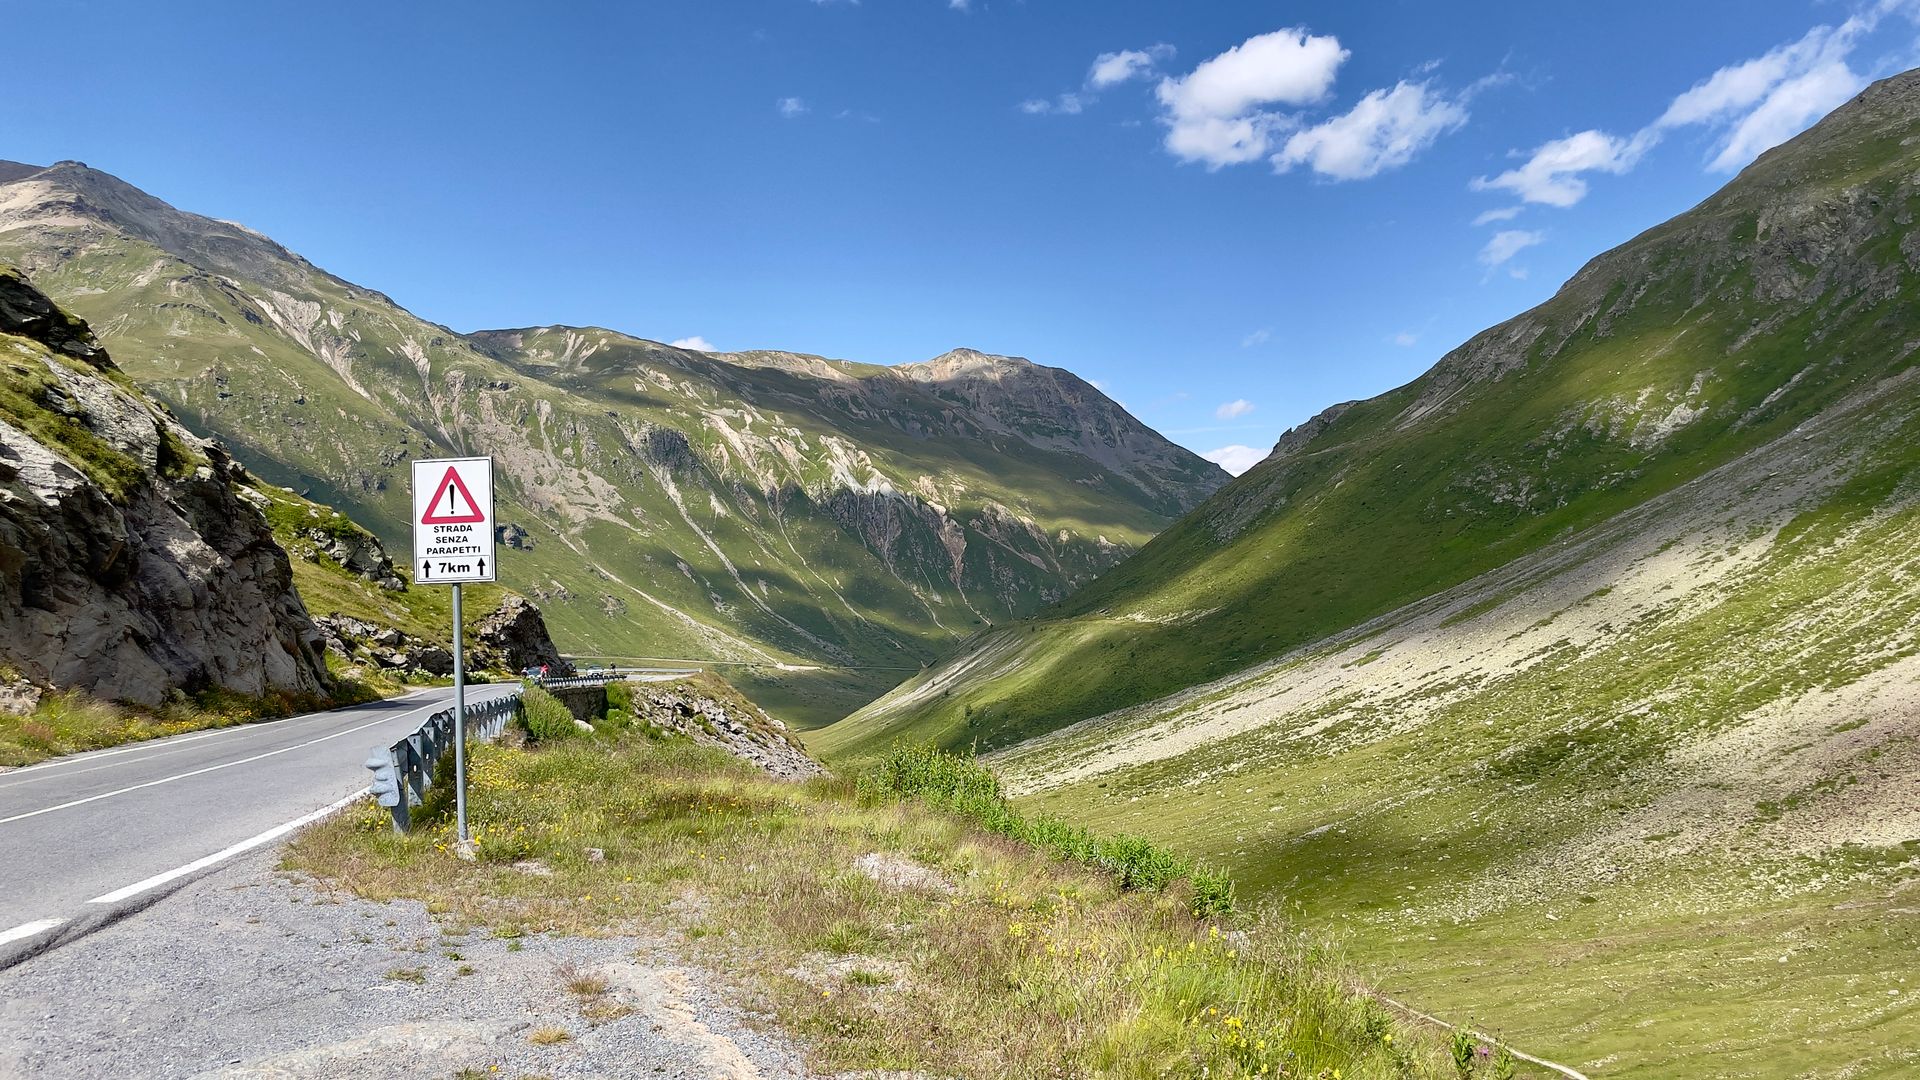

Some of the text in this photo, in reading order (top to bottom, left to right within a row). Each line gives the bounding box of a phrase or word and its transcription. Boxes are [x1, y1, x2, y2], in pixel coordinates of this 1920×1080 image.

[433, 525, 473, 533] STRADA
[435, 536, 469, 544] SENZA
[426, 546, 481, 554] PARAPETTI
[438, 563, 471, 573] 7km
